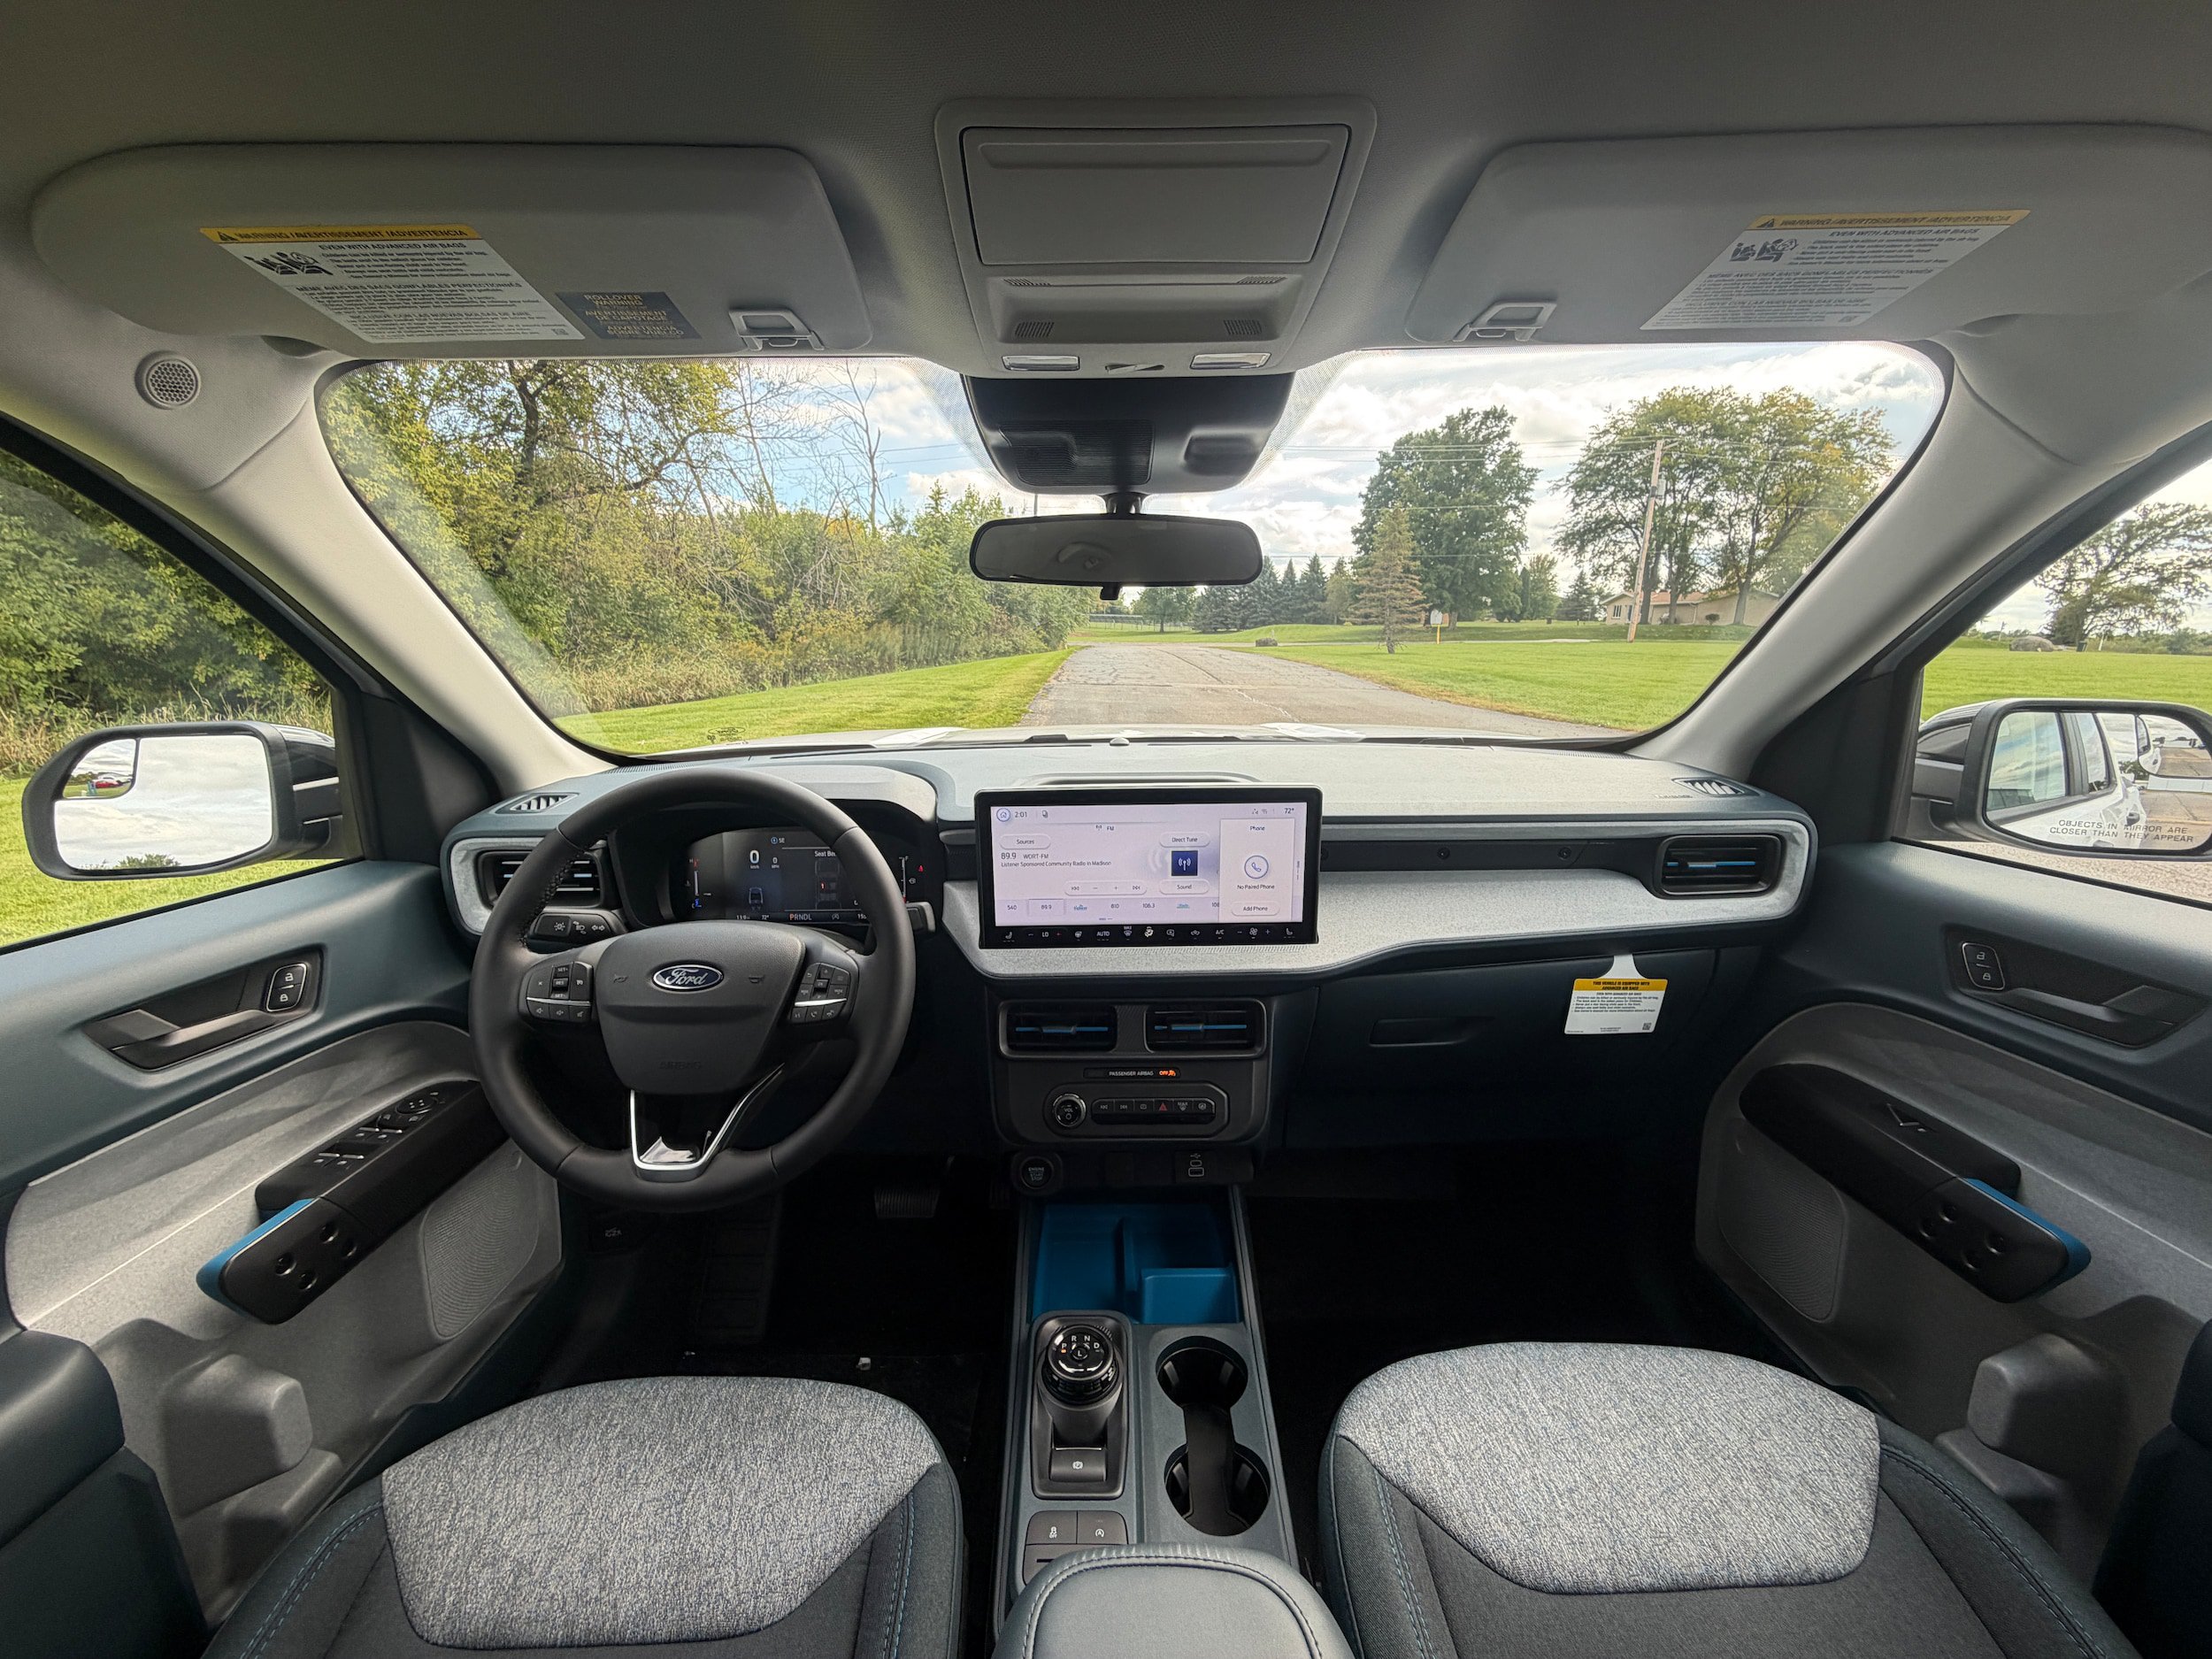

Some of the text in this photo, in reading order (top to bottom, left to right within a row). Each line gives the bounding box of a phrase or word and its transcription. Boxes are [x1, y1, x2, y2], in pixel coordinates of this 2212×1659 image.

[2058, 819, 2102, 829] OBJECTS
[2124, 824, 2162, 833] MIRROR
[2050, 826, 2087, 835] CLOSER
[2124, 832, 2149, 841] THEY
[749, 850, 760, 864] 0
[665, 967, 708, 985] Ford
